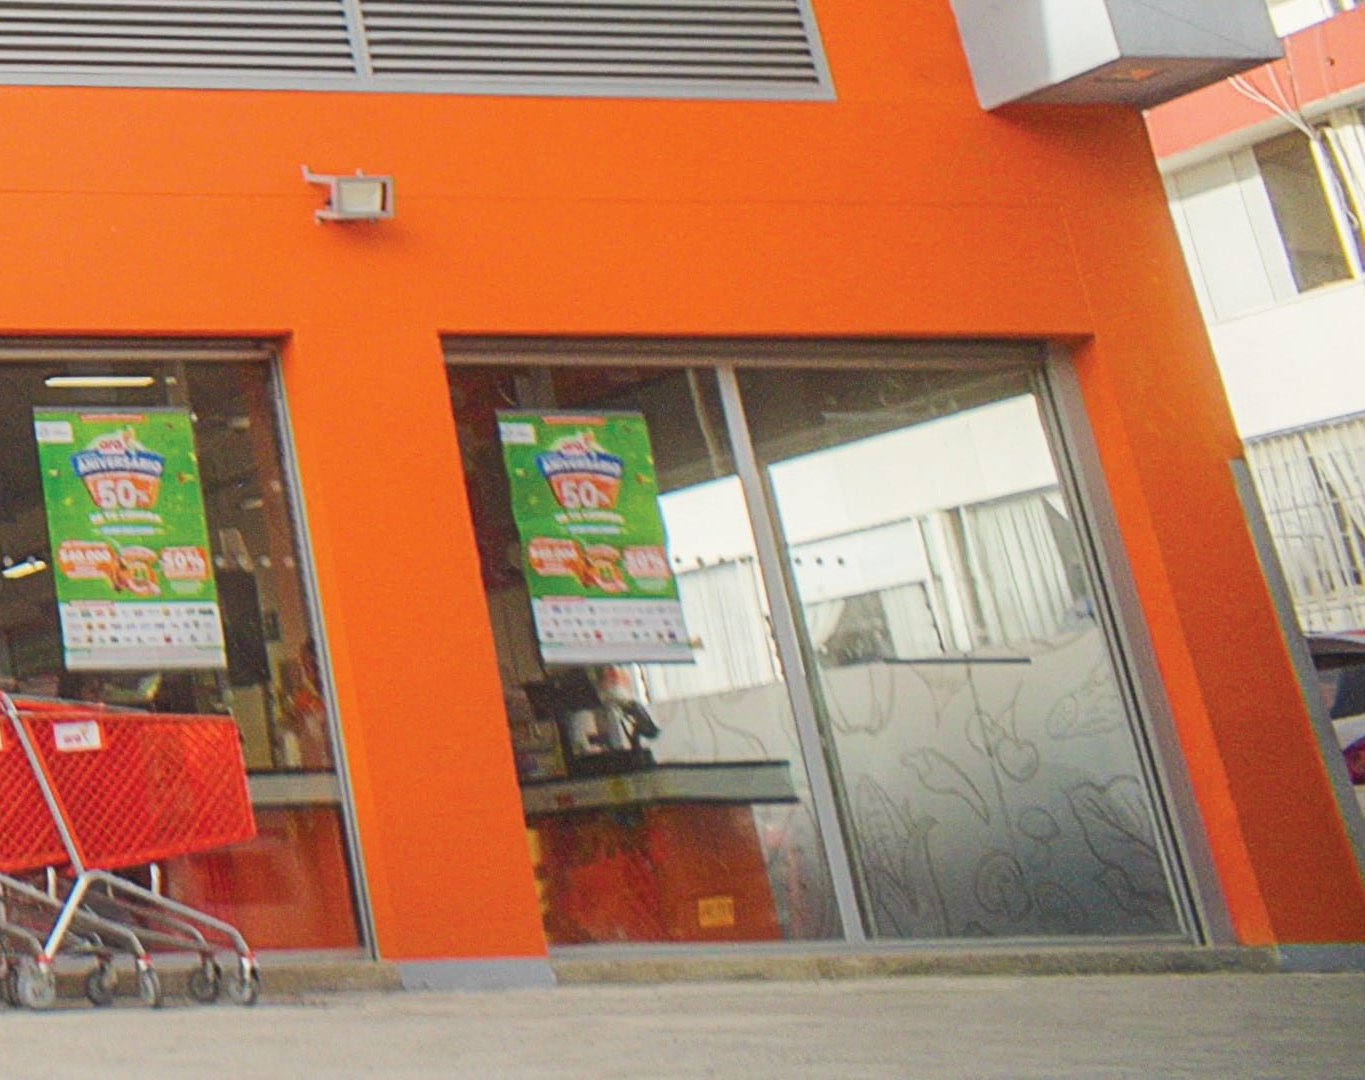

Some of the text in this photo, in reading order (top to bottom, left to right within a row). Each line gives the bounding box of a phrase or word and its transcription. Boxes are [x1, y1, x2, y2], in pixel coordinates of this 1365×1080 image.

[99, 440, 125, 449] ara
[97, 479, 149, 510] 50%
[63, 734, 81, 744] ara
